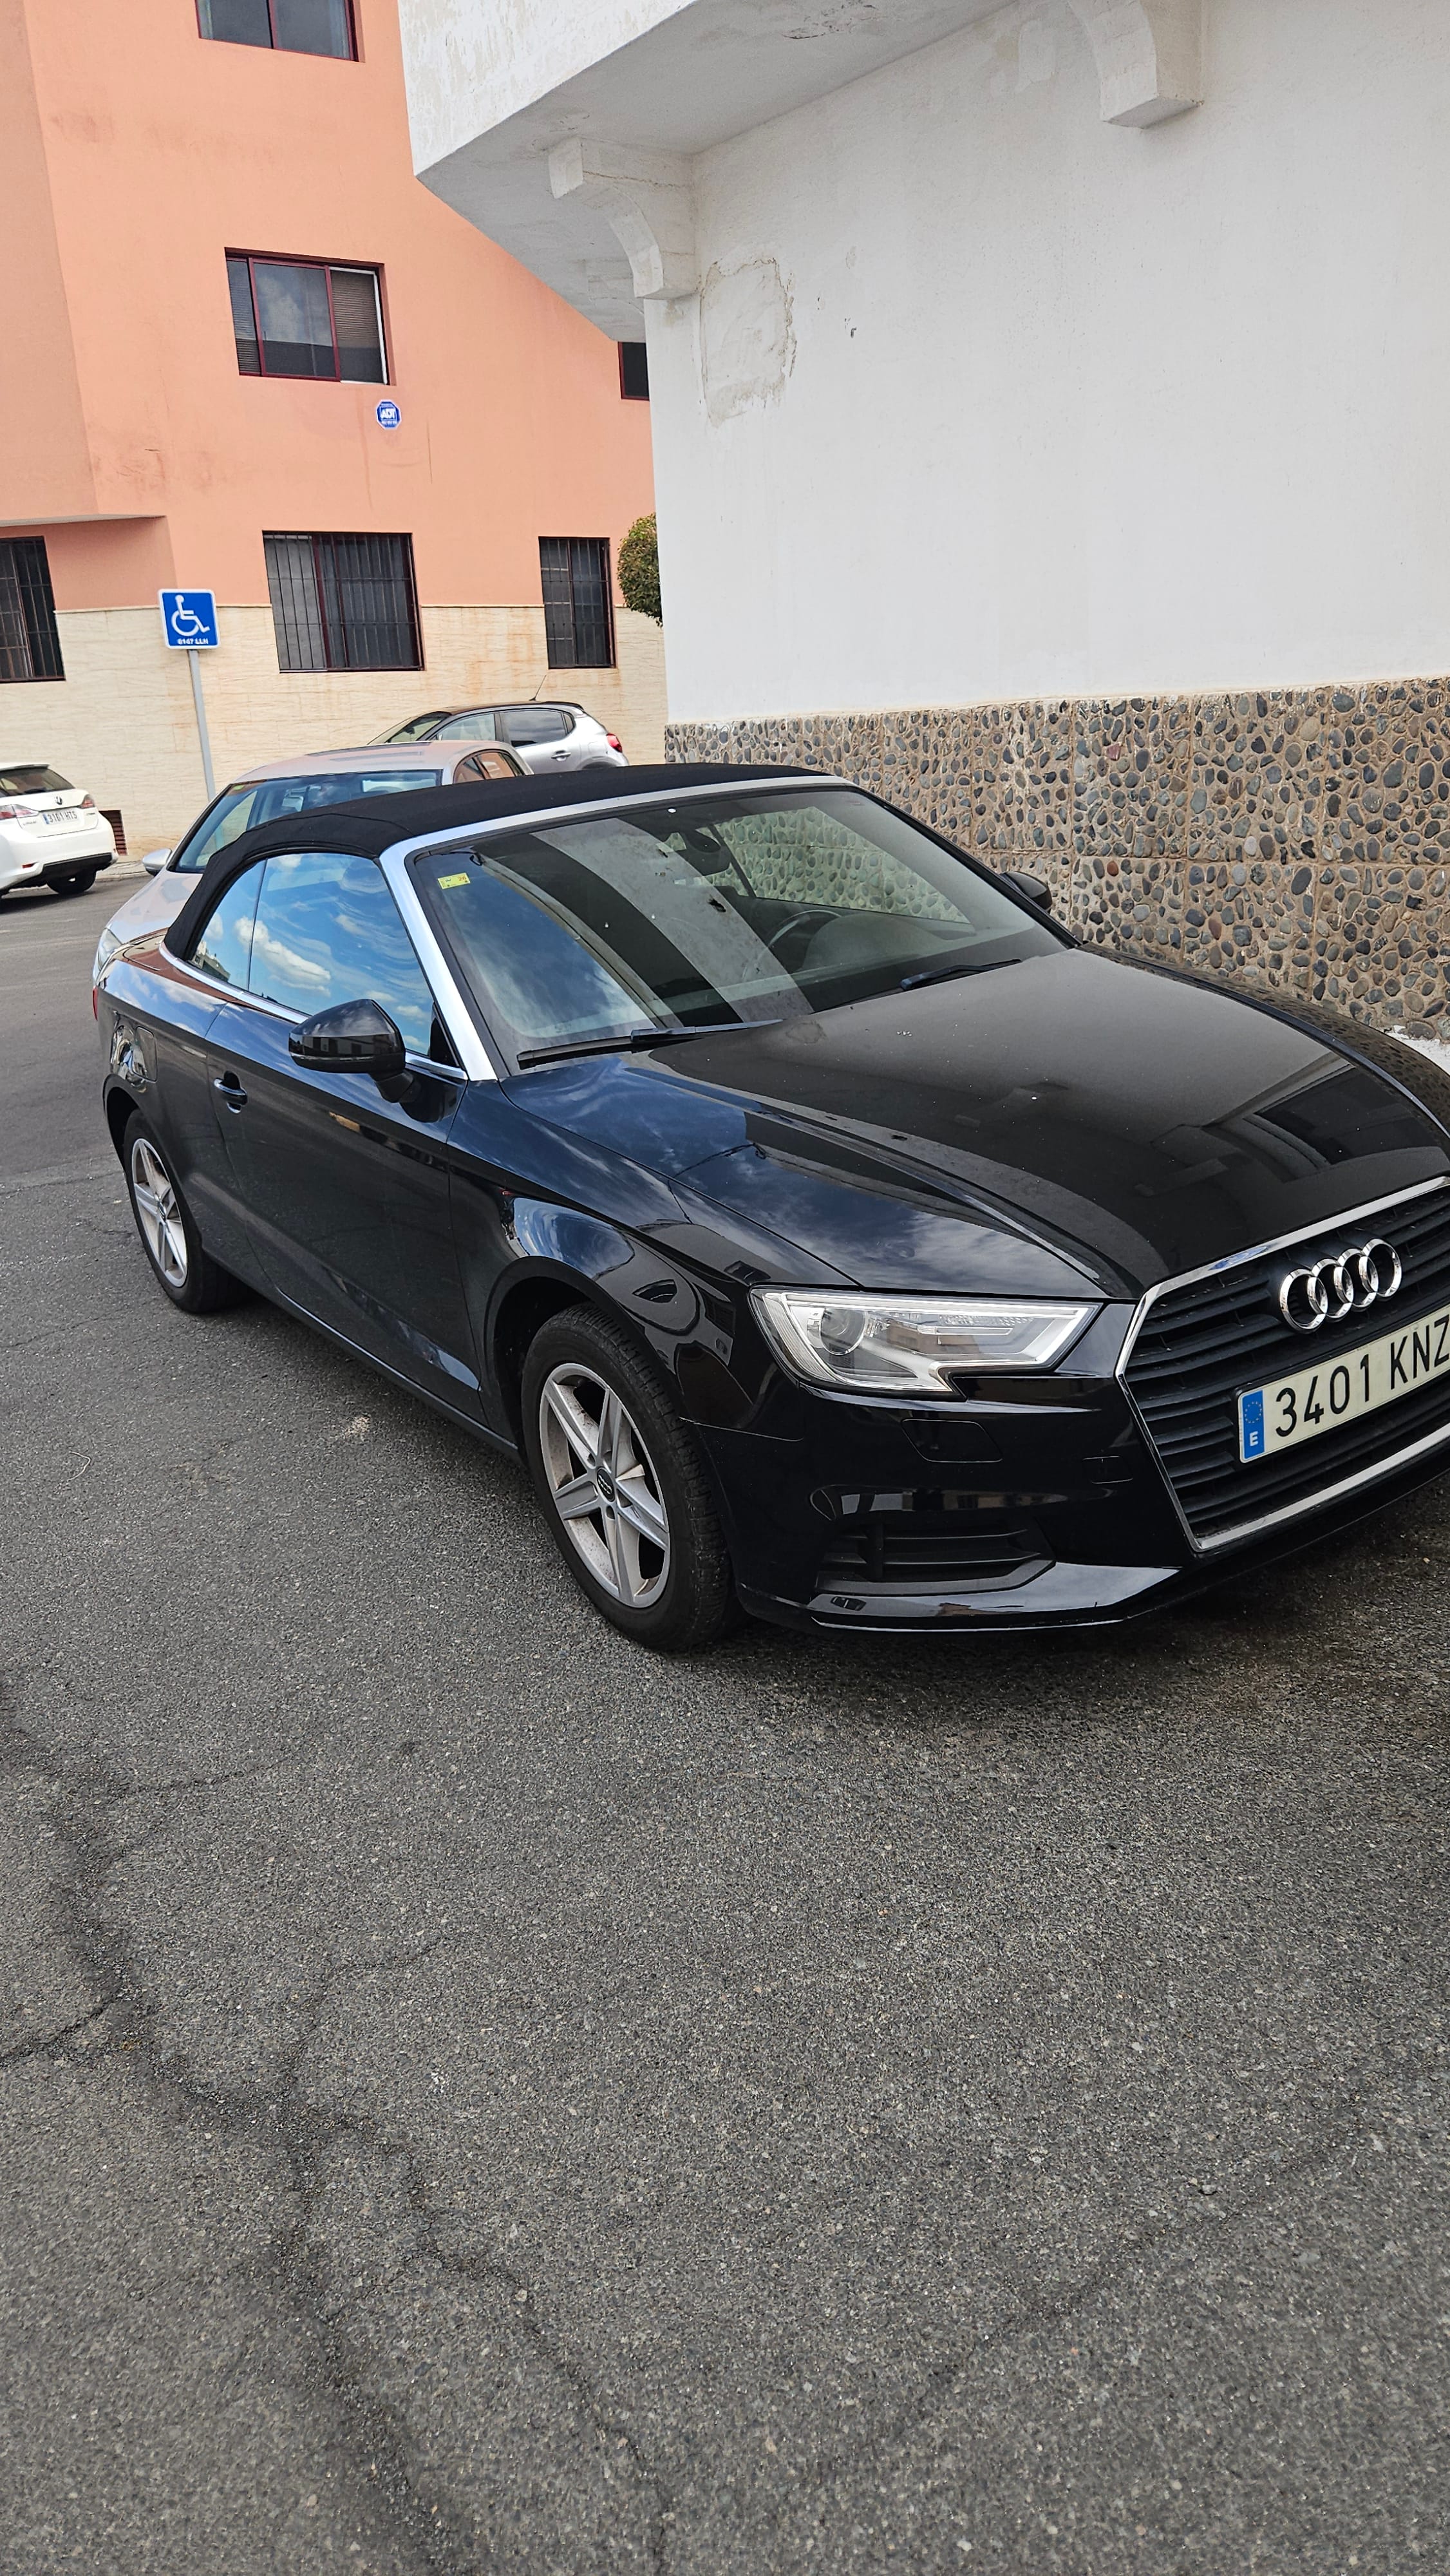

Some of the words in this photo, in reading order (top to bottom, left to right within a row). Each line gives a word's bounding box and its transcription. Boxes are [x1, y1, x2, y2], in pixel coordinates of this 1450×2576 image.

[381, 408, 395, 418] ADT
[65, 811, 78, 820] HTS
[1275, 1354, 1370, 1437] 3401
[1390, 1314, 1450, 1389] KNZ
[1250, 1432, 1259, 1446] E
